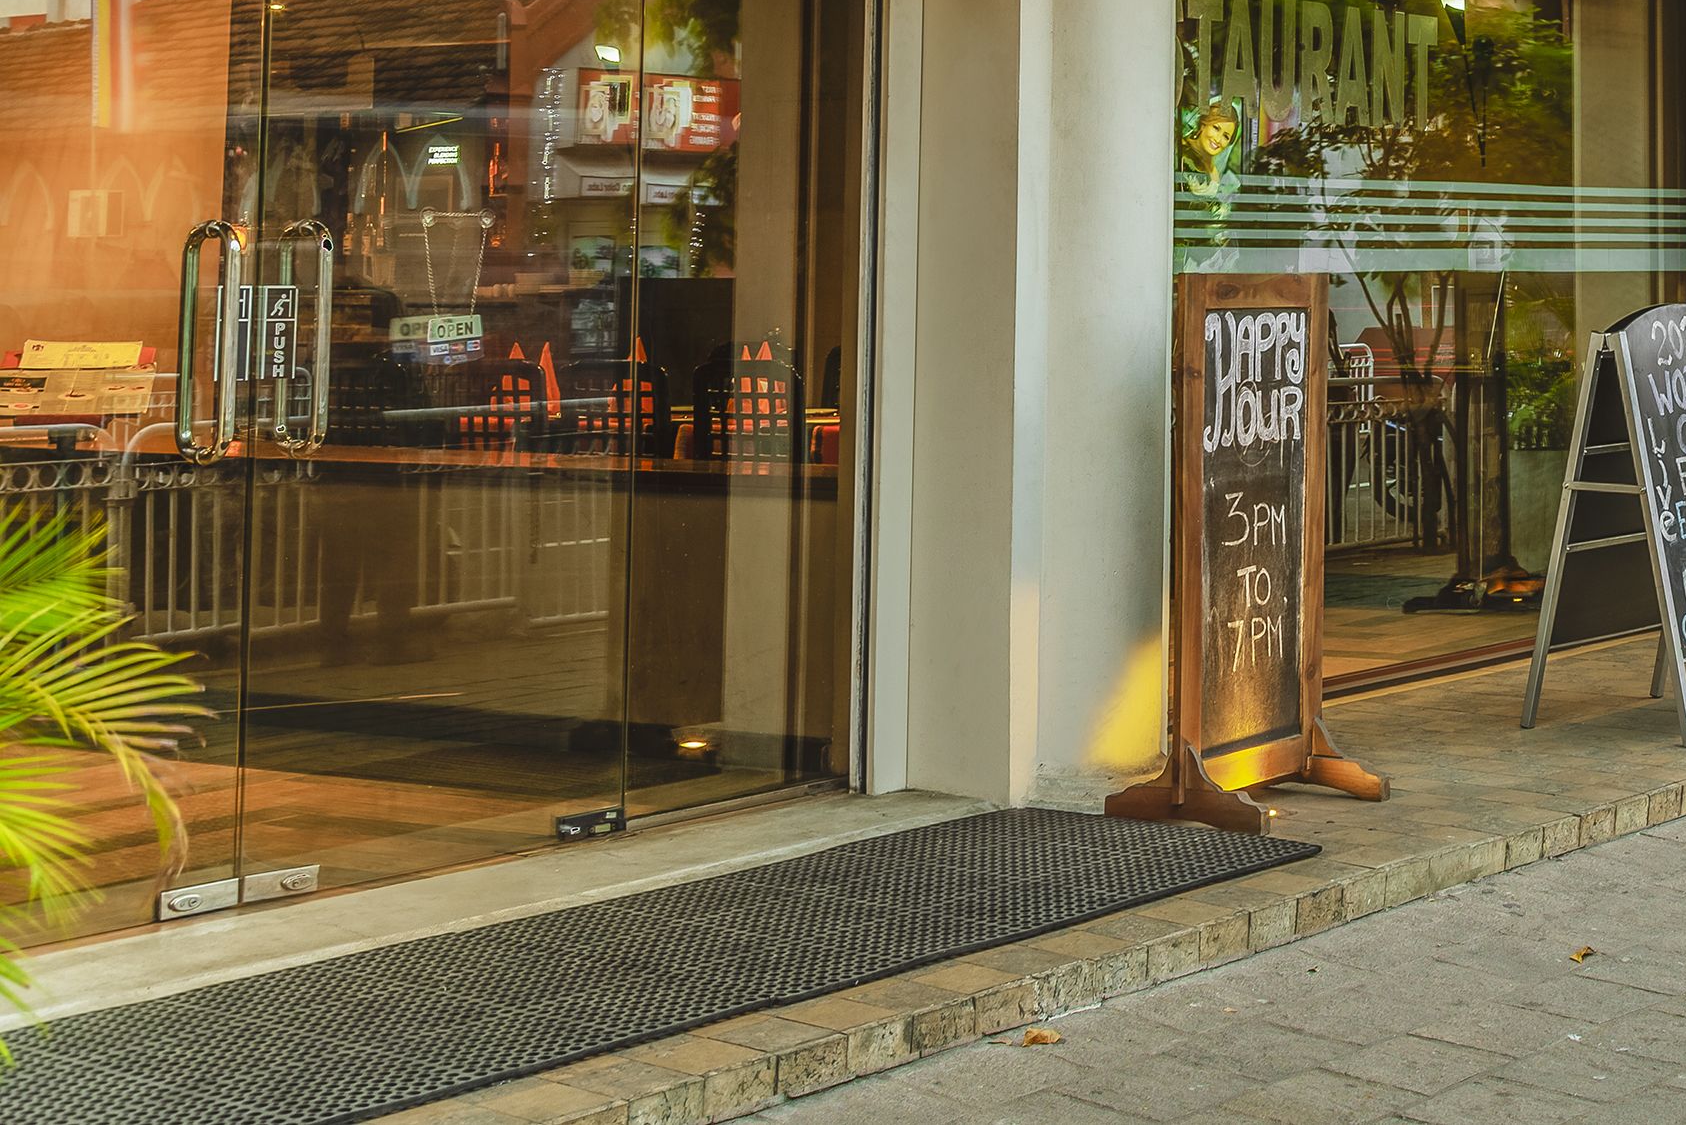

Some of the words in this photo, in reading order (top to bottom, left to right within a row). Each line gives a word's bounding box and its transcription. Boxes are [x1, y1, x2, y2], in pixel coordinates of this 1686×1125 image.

[272, 322, 286, 378] PUSH
[433, 345, 448, 354] VISA
[437, 321, 473, 338] OPEN
[1204, 311, 1306, 384] HAPPY
[1203, 383, 1304, 452] HOUR
[1236, 564, 1272, 608] TO
